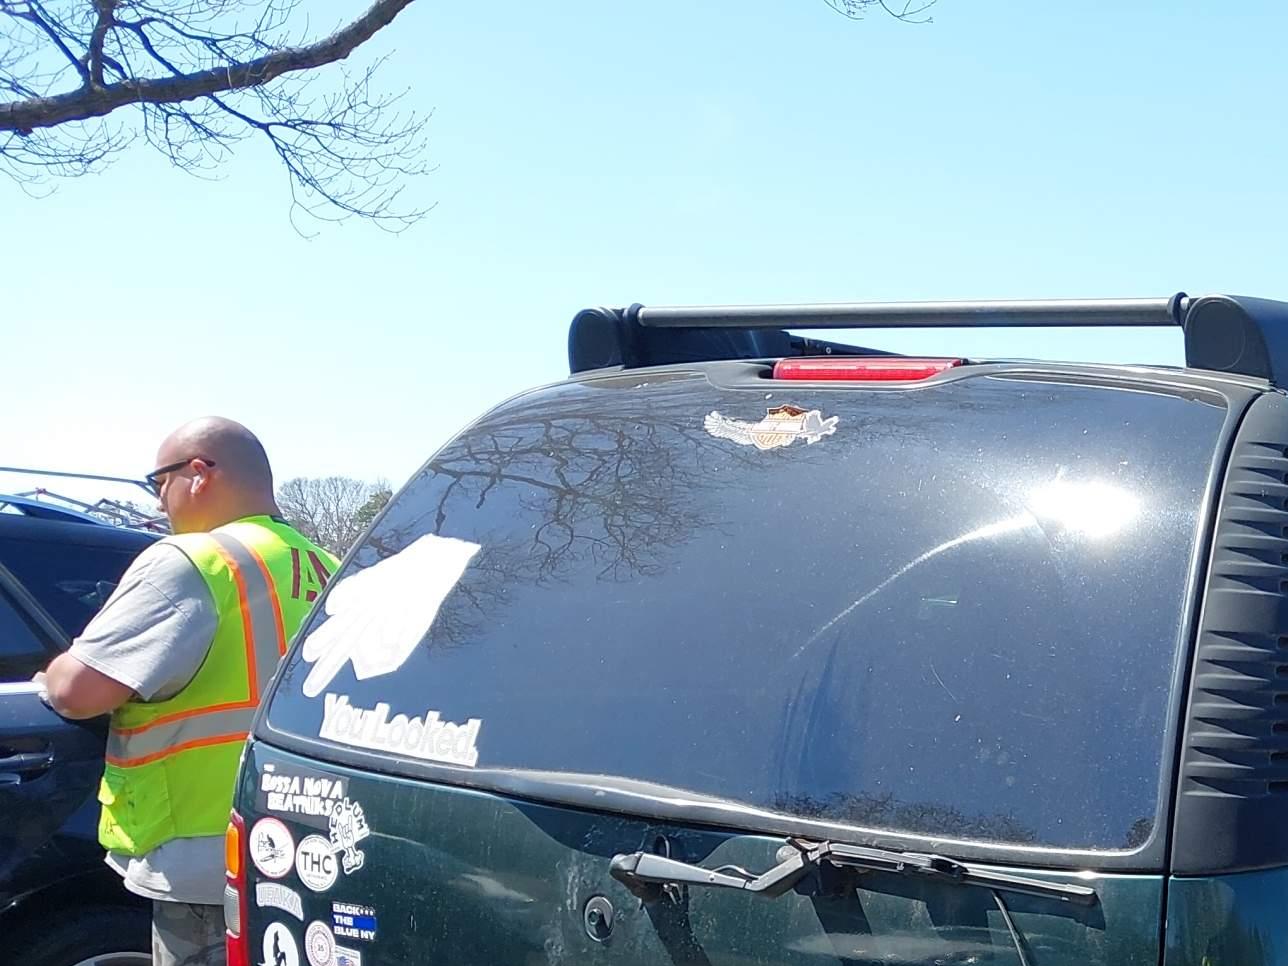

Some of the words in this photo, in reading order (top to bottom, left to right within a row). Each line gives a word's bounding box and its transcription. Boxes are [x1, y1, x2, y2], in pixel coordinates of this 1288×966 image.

[322, 694, 368, 740] You
[303, 776, 343, 799] NOVA
[301, 851, 332, 875] THC
[332, 902, 360, 916] BACK
[333, 914, 354, 926] THE
[333, 925, 360, 938] BLUE
[361, 928, 376, 940] NY
